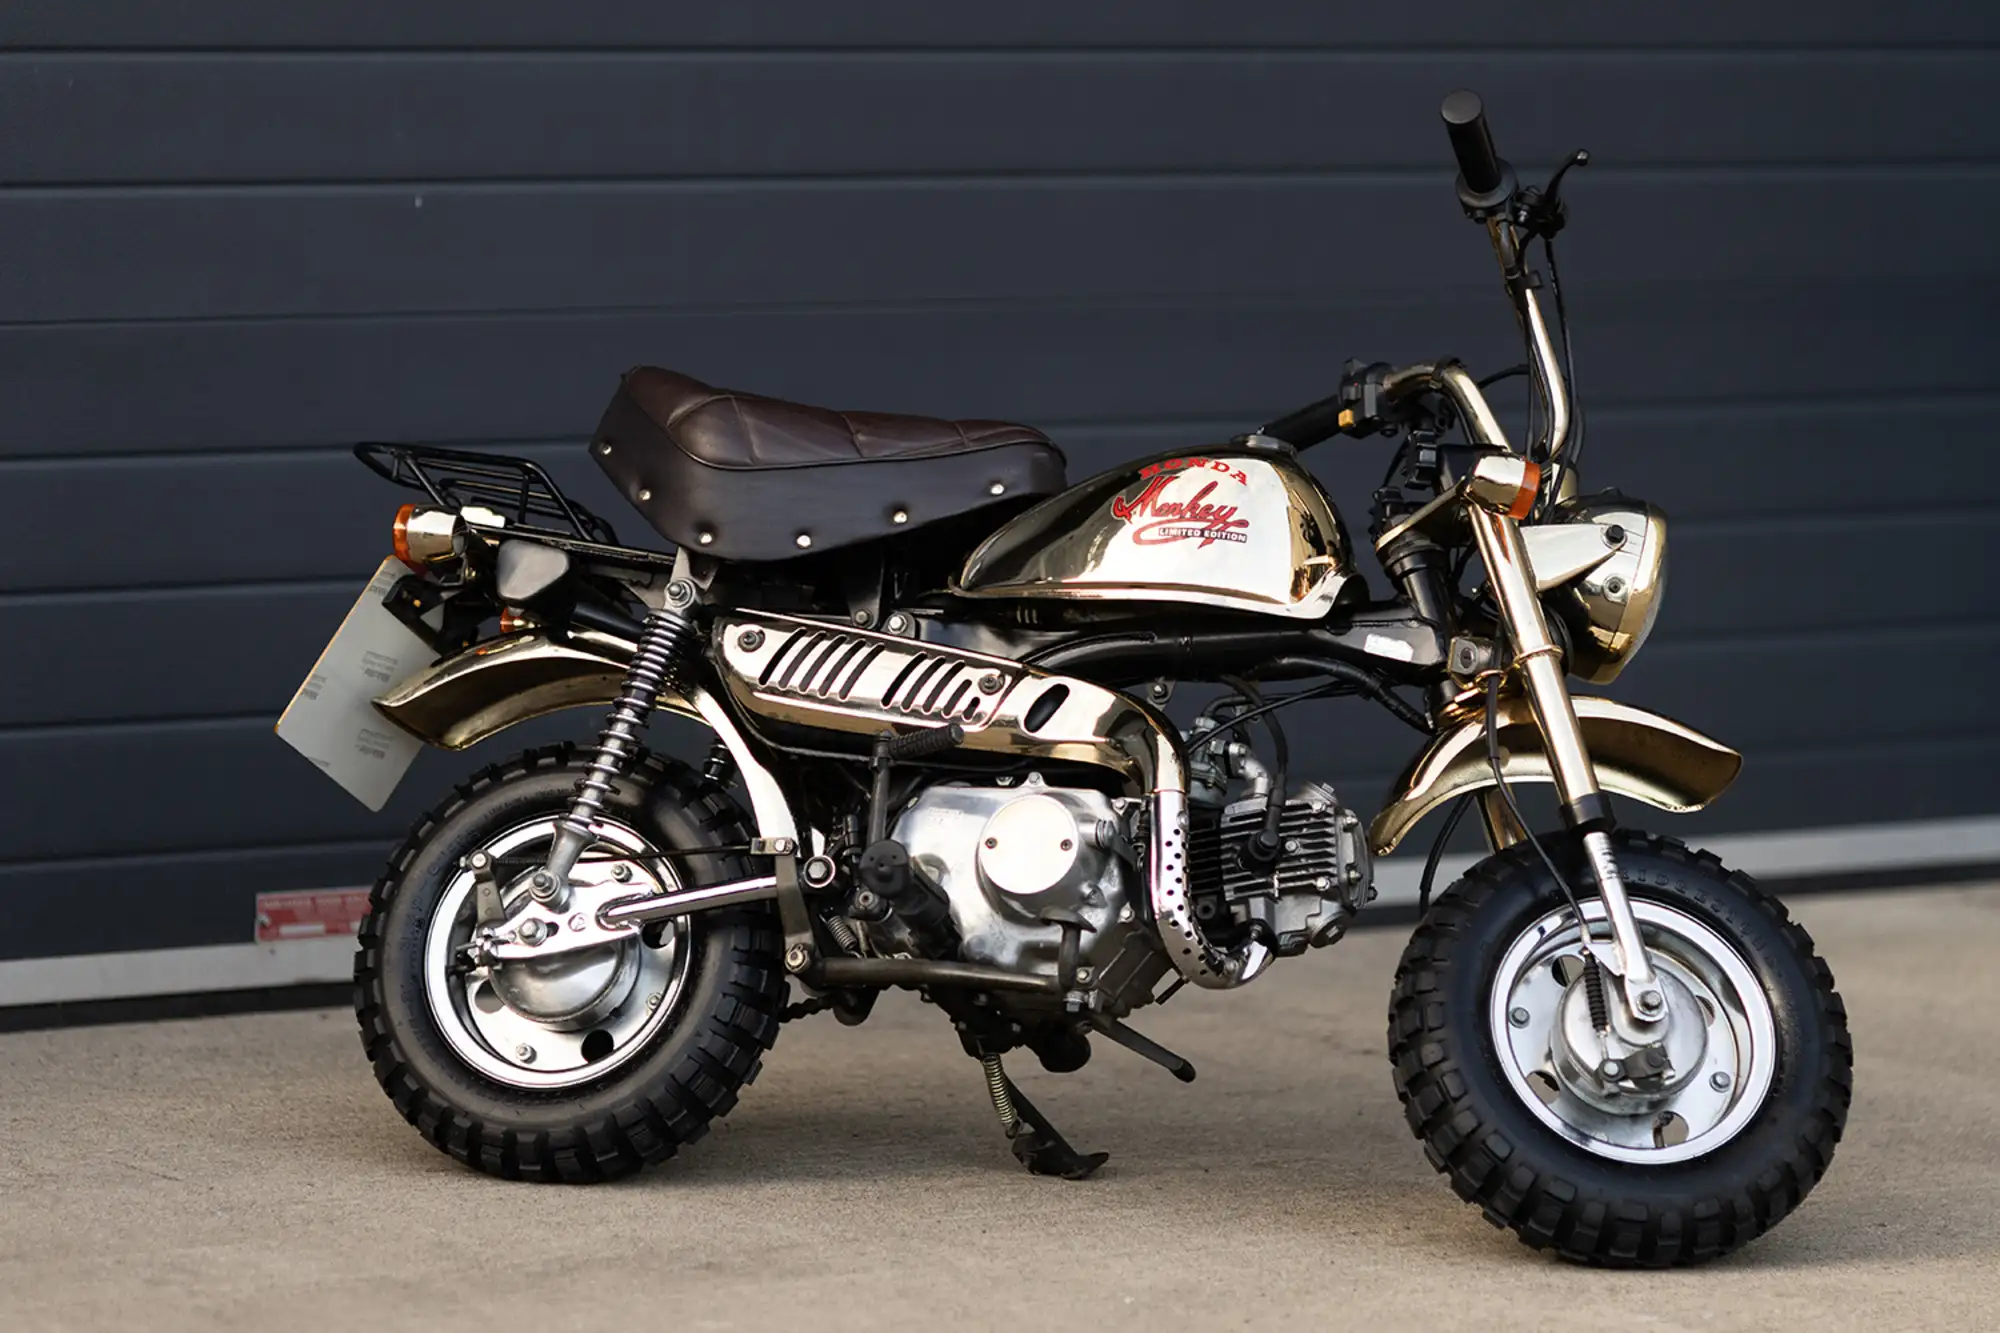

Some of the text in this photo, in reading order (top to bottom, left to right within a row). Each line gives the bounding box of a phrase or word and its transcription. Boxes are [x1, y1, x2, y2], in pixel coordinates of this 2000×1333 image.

[1138, 457, 1247, 486] HONDA
[1113, 476, 1249, 549] Monkey
[1159, 528, 1247, 542] LIMITED EDITION
